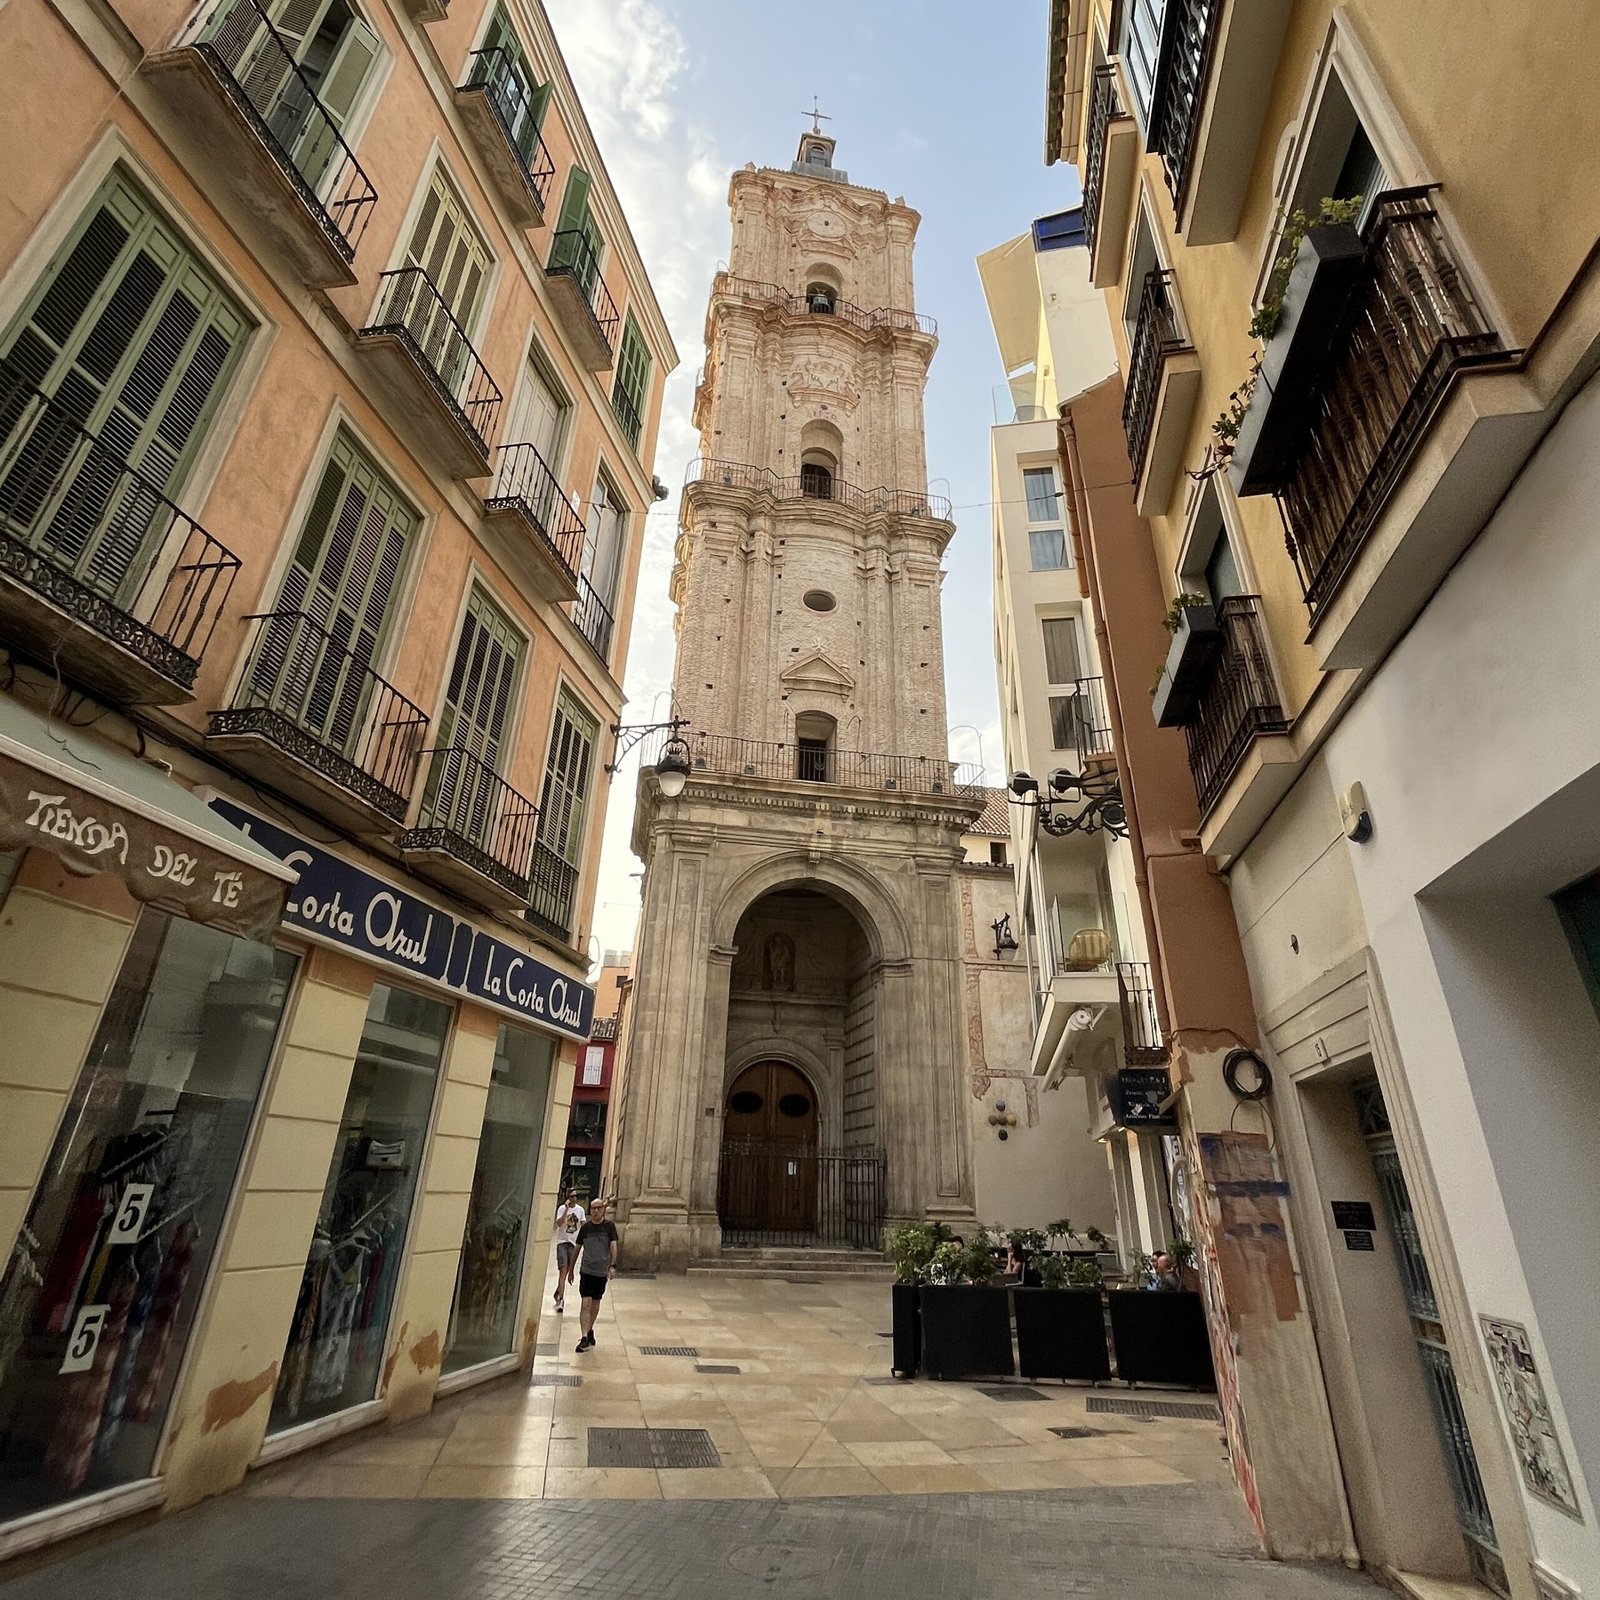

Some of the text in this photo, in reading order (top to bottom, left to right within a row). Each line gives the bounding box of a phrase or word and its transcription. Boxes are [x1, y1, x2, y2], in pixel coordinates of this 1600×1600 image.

[25, 790, 243, 908] TIENDA DEL TÉ
[364, 890, 435, 964] Azul
[483, 944, 584, 1029] La Costa Azul
[118, 1193, 145, 1232] 5
[72, 1315, 101, 1358] 5
